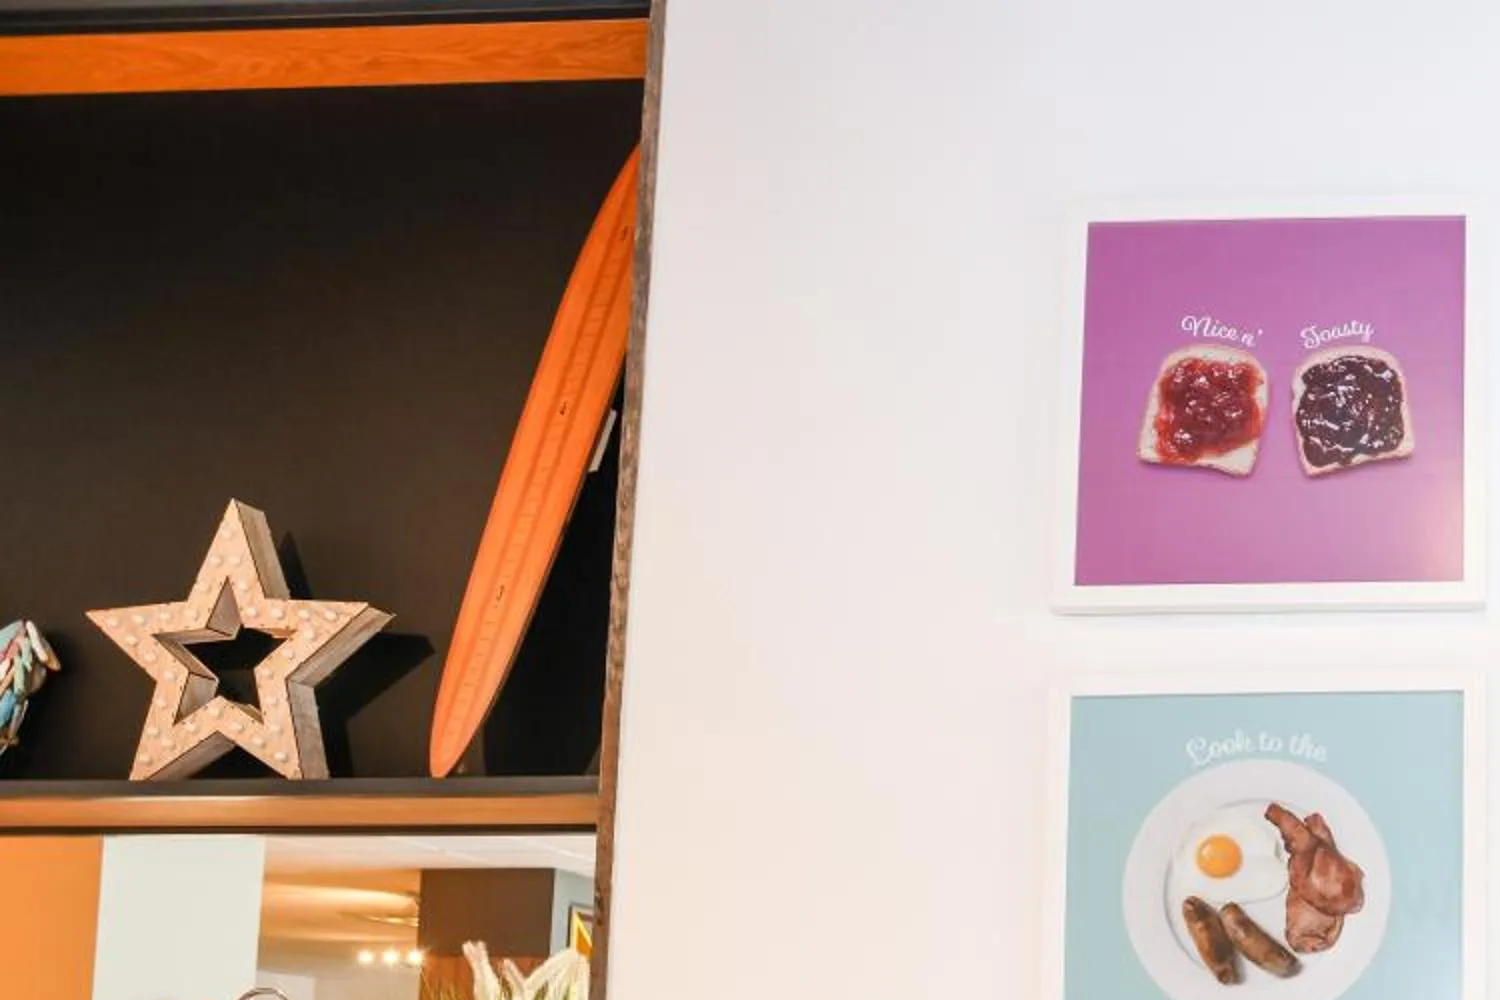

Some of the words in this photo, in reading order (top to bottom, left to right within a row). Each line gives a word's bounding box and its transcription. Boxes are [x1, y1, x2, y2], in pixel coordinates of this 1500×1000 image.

[1181, 316, 1238, 341] Nice
[1300, 320, 1374, 348] Toasty
[1186, 728, 1252, 766] Cook
[1259, 732, 1284, 752] to
[1289, 733, 1328, 762] the
